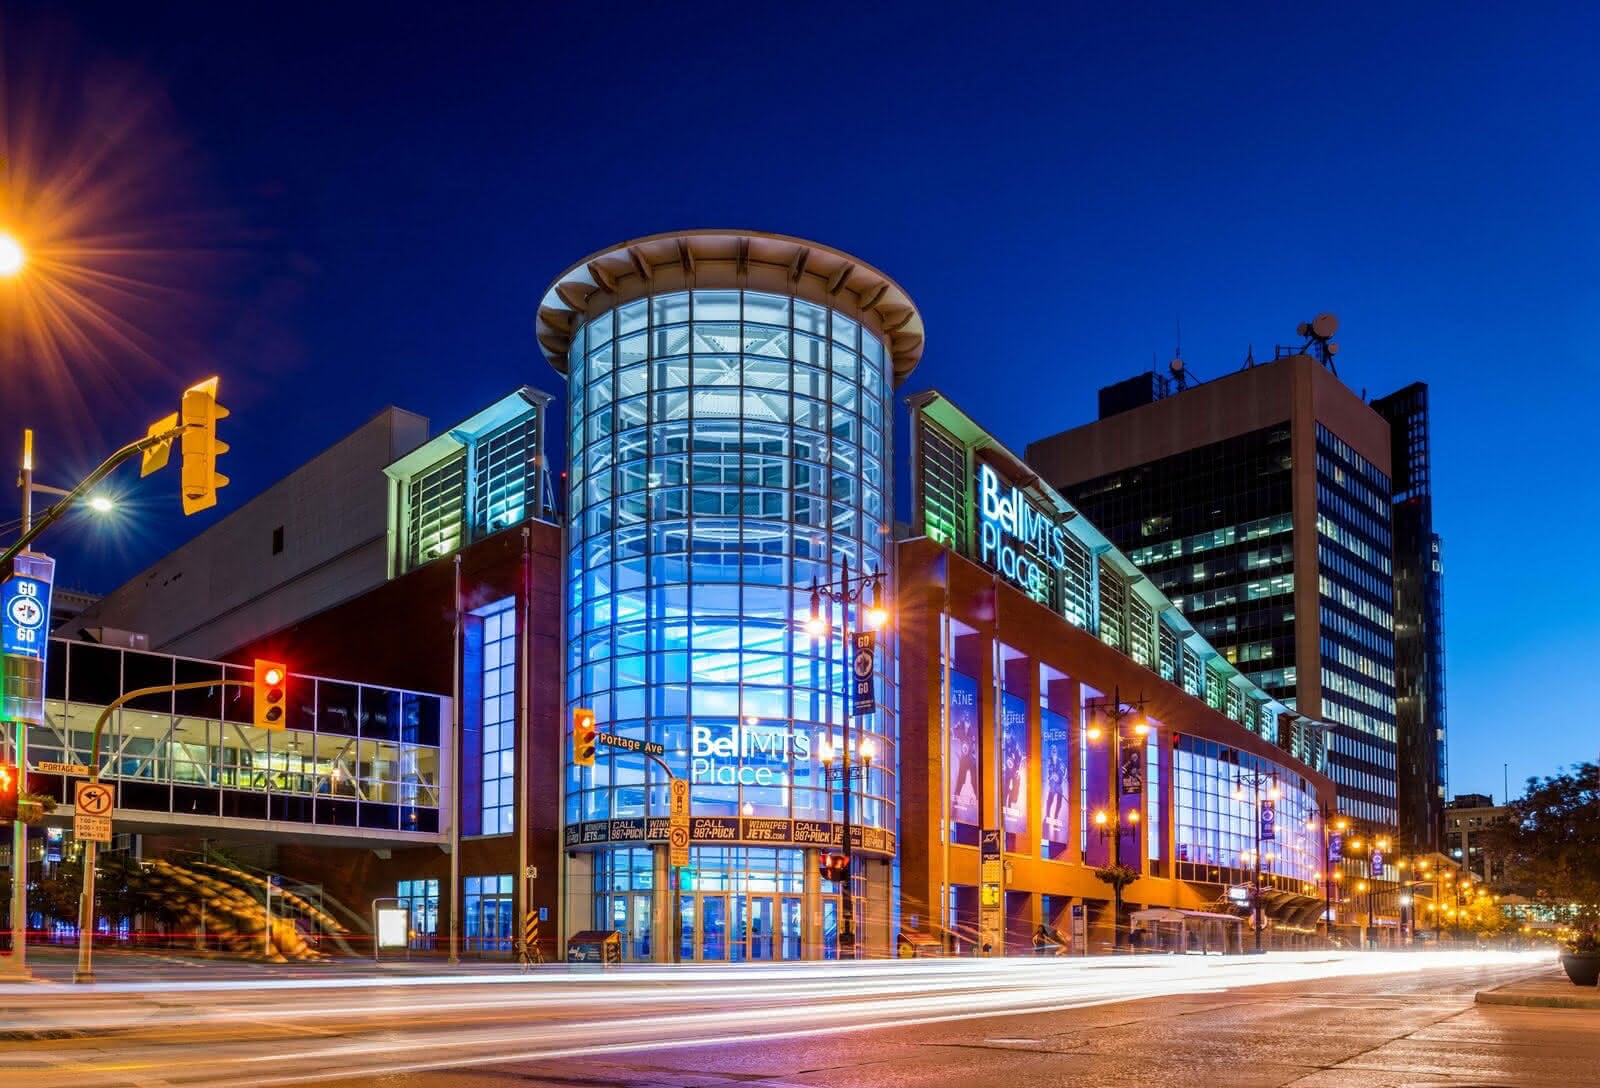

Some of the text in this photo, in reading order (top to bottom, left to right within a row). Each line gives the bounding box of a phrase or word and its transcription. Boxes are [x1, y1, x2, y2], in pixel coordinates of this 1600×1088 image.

[982, 521, 1040, 593] Place
[18, 581, 36, 596] GO
[17, 628, 35, 642] GO
[857, 635, 870, 648] GO
[857, 682, 869, 694] GO
[951, 694, 973, 705] AINE
[600, 733, 663, 754] Portage Ave
[43, 763, 74, 773] PORTAGE
[692, 758, 773, 785] Place
[613, 821, 636, 829] CALL
[649, 820, 671, 828] WINN
[695, 820, 725, 828] CALL
[749, 820, 788, 830] WINNIPEG
[796, 822, 821, 832] CALL
[648, 828, 671, 838] JETS
